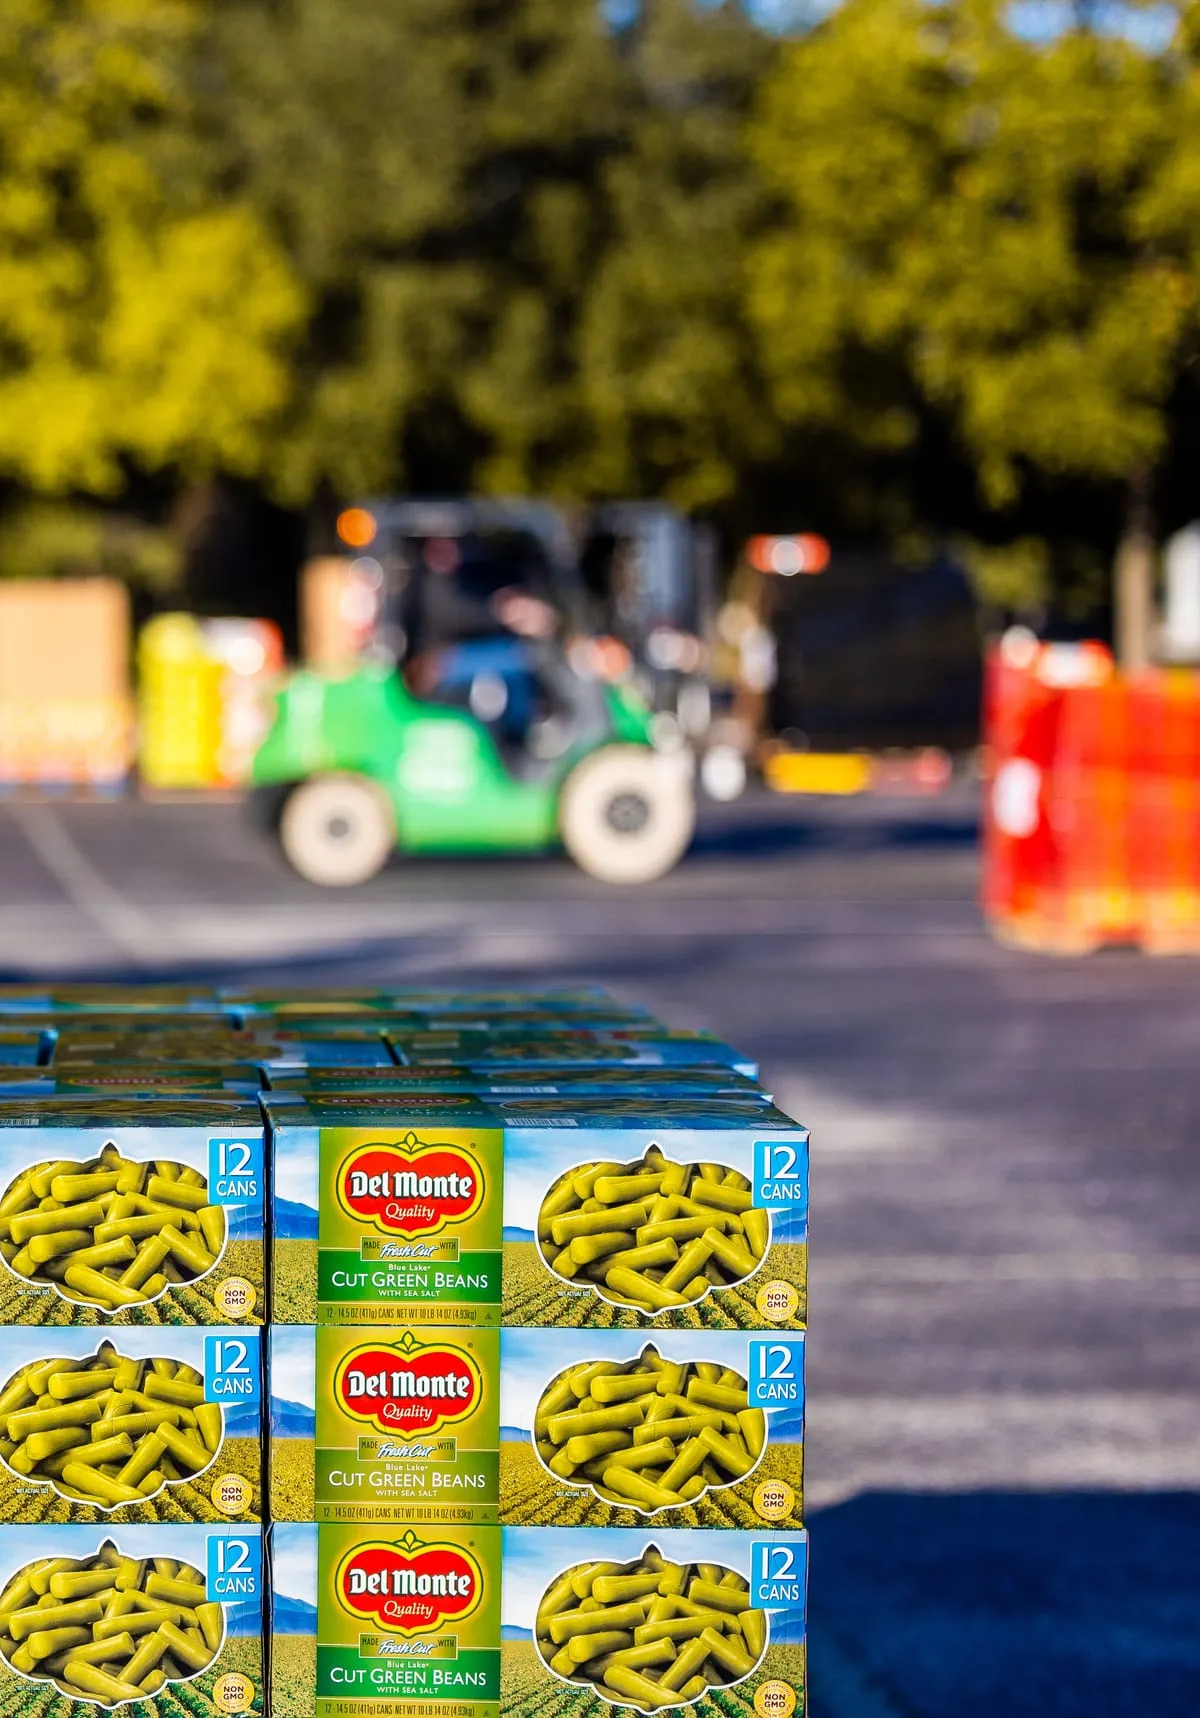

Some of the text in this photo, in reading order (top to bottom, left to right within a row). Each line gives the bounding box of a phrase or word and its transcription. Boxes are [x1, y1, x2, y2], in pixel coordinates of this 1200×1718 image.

[218, 1142, 254, 1176] 12
[763, 1144, 798, 1179] 12
[216, 1180, 256, 1197] CANS
[350, 1170, 473, 1198] Del Monte
[760, 1182, 800, 1199] CANS
[385, 1203, 435, 1222] Quality
[364, 1241, 456, 1250] MADE WITH
[379, 1242, 440, 1258] Fresh Cut
[331, 1271, 488, 1288] CUT GREEN BEANS
[224, 1297, 246, 1305] GMO
[214, 1340, 250, 1374] 12
[760, 1345, 795, 1379] 12
[212, 1377, 252, 1394] CANS
[348, 1371, 470, 1398] Del Monte
[756, 1383, 797, 1400] CANS
[383, 1403, 433, 1422] Quality
[328, 1470, 486, 1488] CUT GREEN BEANS
[221, 1494, 243, 1502] GMO
[763, 1500, 784, 1508] GMO
[217, 1539, 252, 1574] 12
[762, 1546, 797, 1581] 12
[214, 1577, 255, 1594] CANS
[349, 1568, 472, 1596] Del Monte
[758, 1584, 799, 1601] CANS
[384, 1600, 434, 1620] Quality
[378, 1639, 438, 1656] Fresh Cut
[386, 1660, 404, 1668] Blue
[330, 1667, 487, 1686] CUT GREEN BEANS
[402, 1686, 416, 1694] SEA
